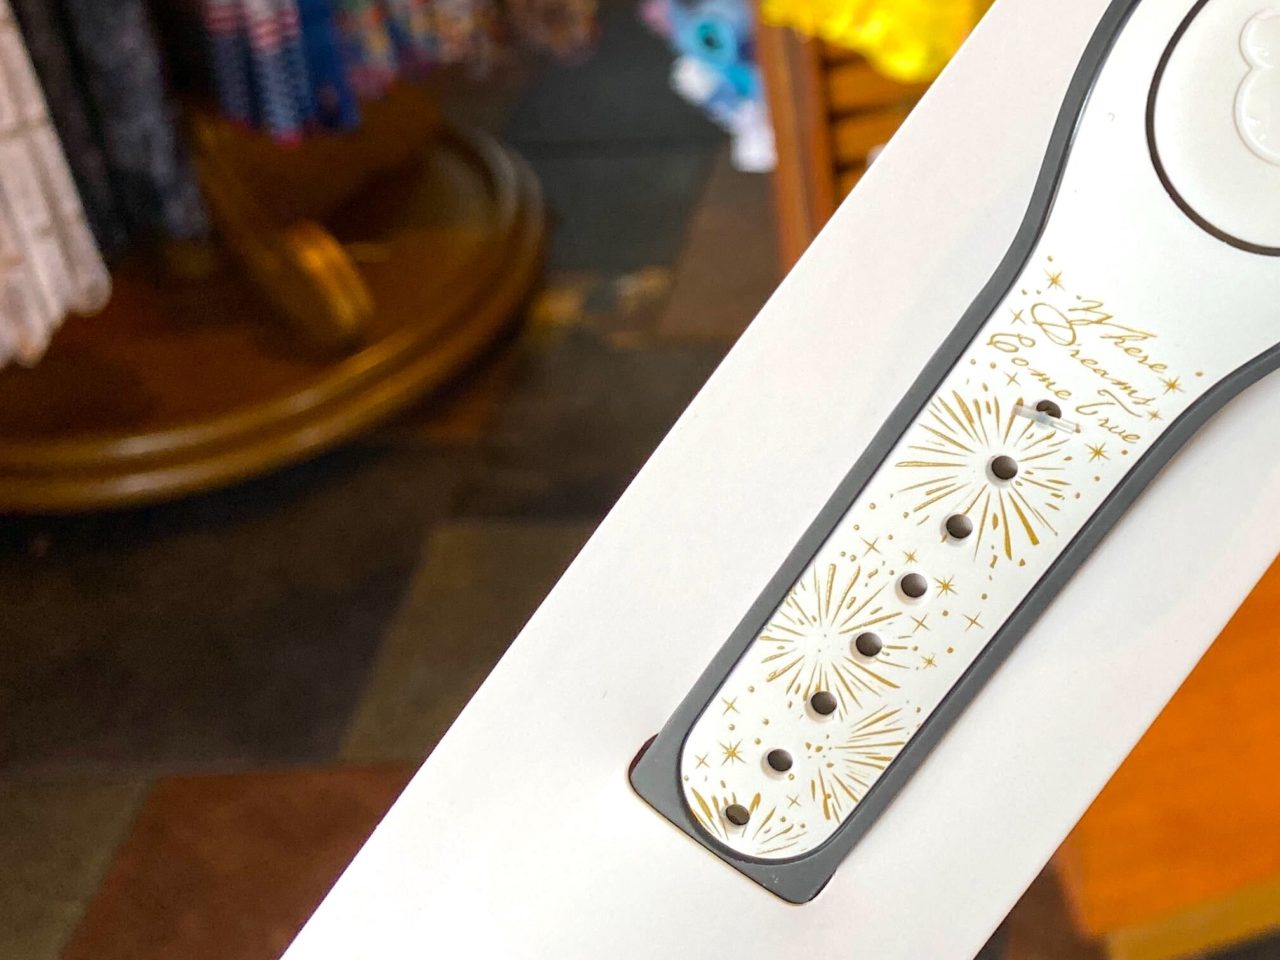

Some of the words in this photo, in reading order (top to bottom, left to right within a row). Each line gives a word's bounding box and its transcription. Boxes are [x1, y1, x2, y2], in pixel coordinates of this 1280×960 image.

[987, 333, 1073, 400] Come
[1075, 389, 1143, 444] True
[1031, 302, 1157, 406] Dreams
[1067, 301, 1168, 373] Where
